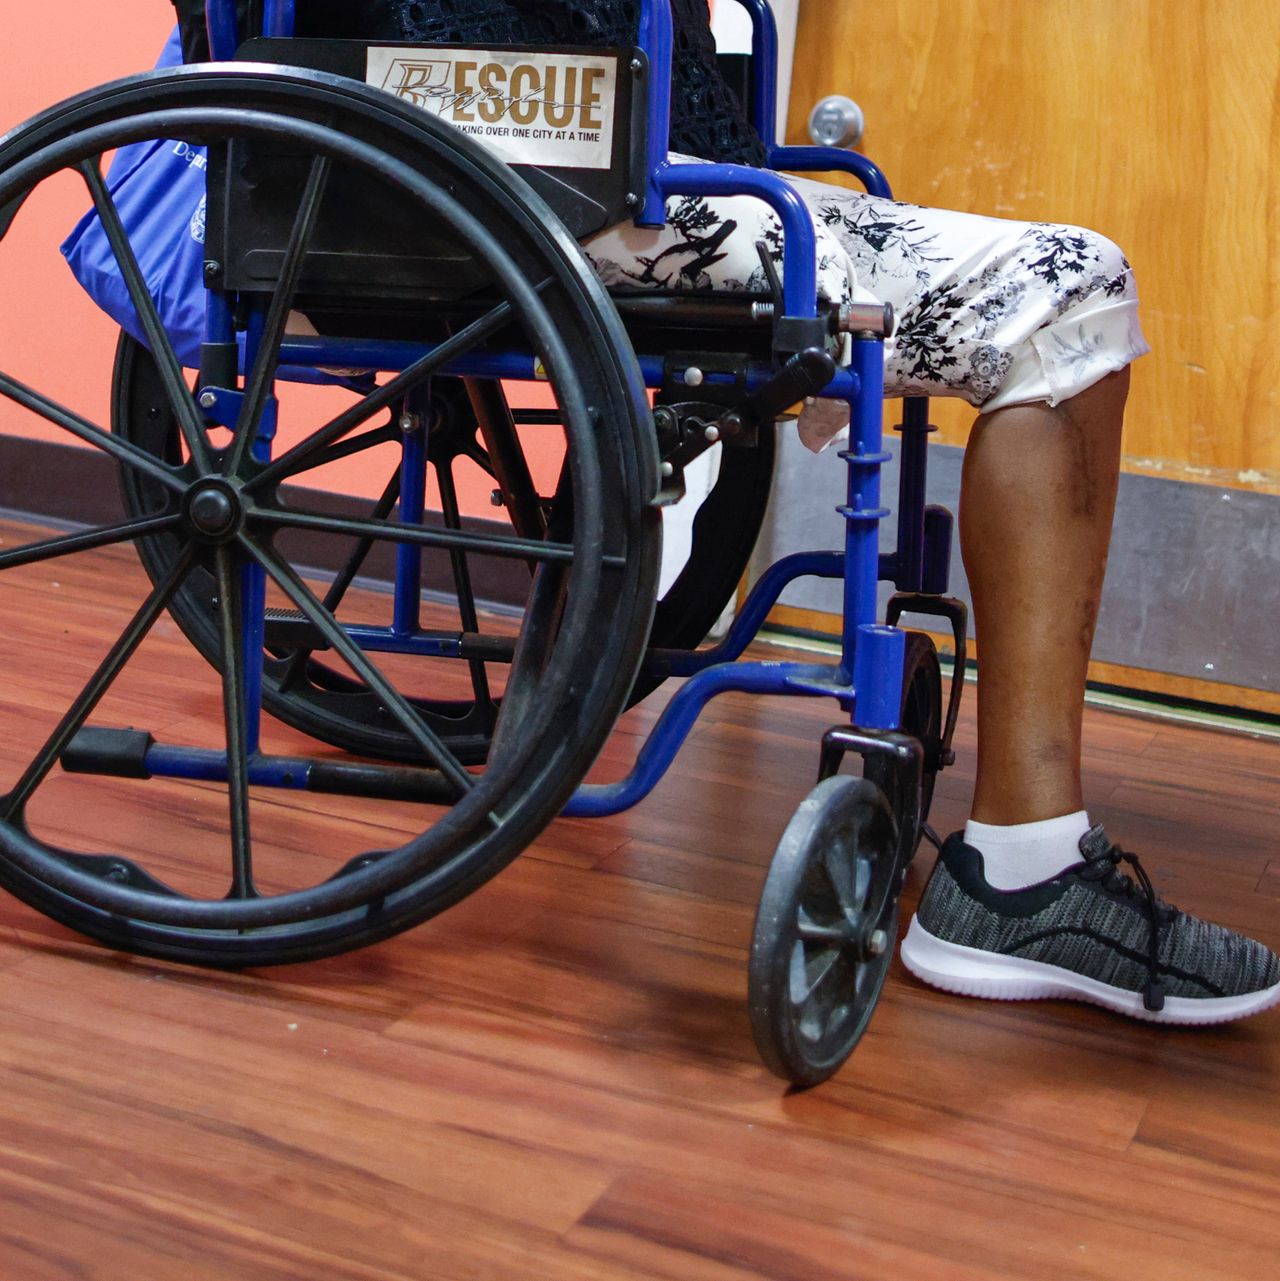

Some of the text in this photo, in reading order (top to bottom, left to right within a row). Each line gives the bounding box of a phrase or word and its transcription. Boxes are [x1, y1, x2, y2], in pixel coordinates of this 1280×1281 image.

[485, 128, 510, 138] OVER
[512, 128, 531, 139] ONE
[532, 129, 554, 140] CITY
[555, 130, 567, 141] AT
[568, 131, 576, 141] A
[577, 131, 601, 143] TIME
